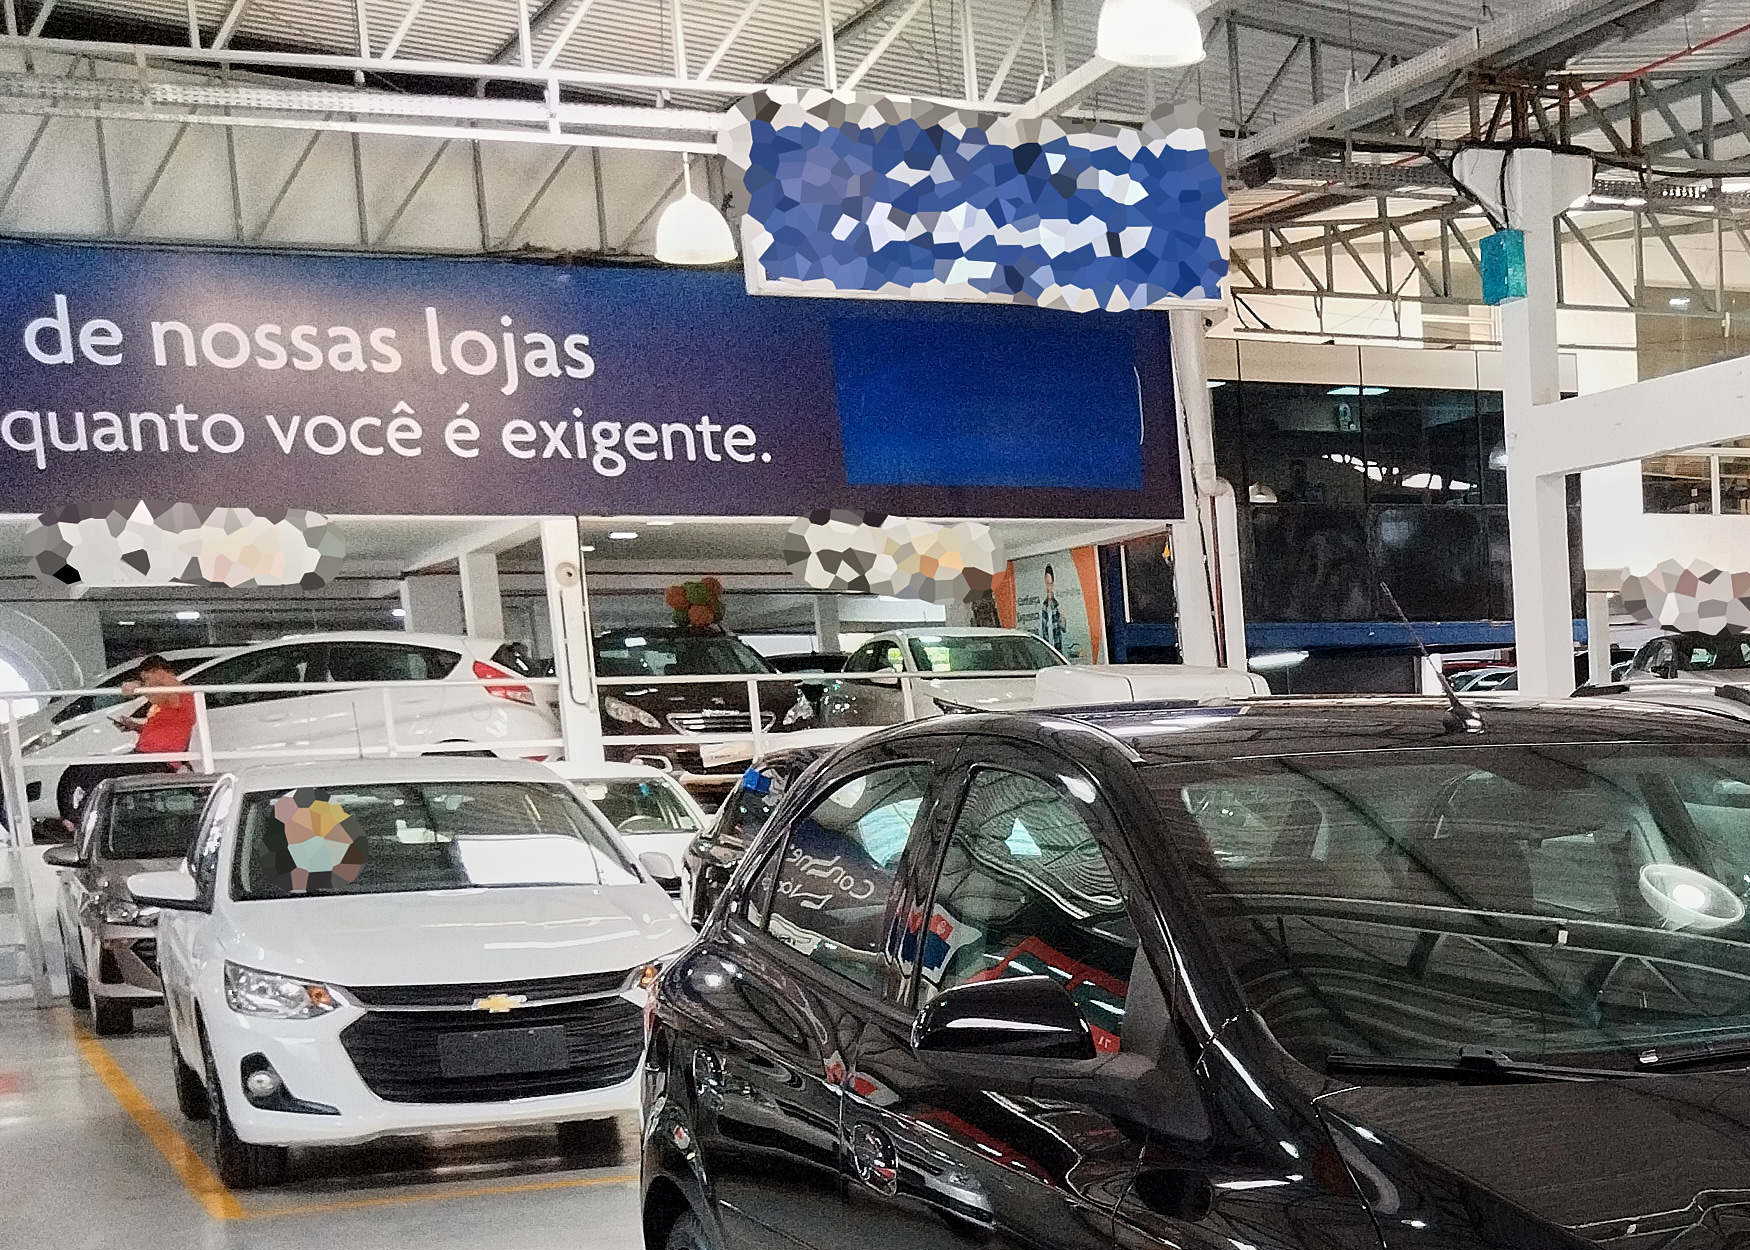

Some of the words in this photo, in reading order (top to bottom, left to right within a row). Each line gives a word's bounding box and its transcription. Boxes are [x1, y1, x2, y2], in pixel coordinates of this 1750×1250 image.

[24, 293, 124, 366] de
[150, 317, 403, 374] nossas
[425, 306, 597, 397] lojas
[0, 403, 246, 471] quanto
[265, 400, 424, 457] você
[444, 402, 482, 459] é
[501, 406, 773, 478] exigente.
